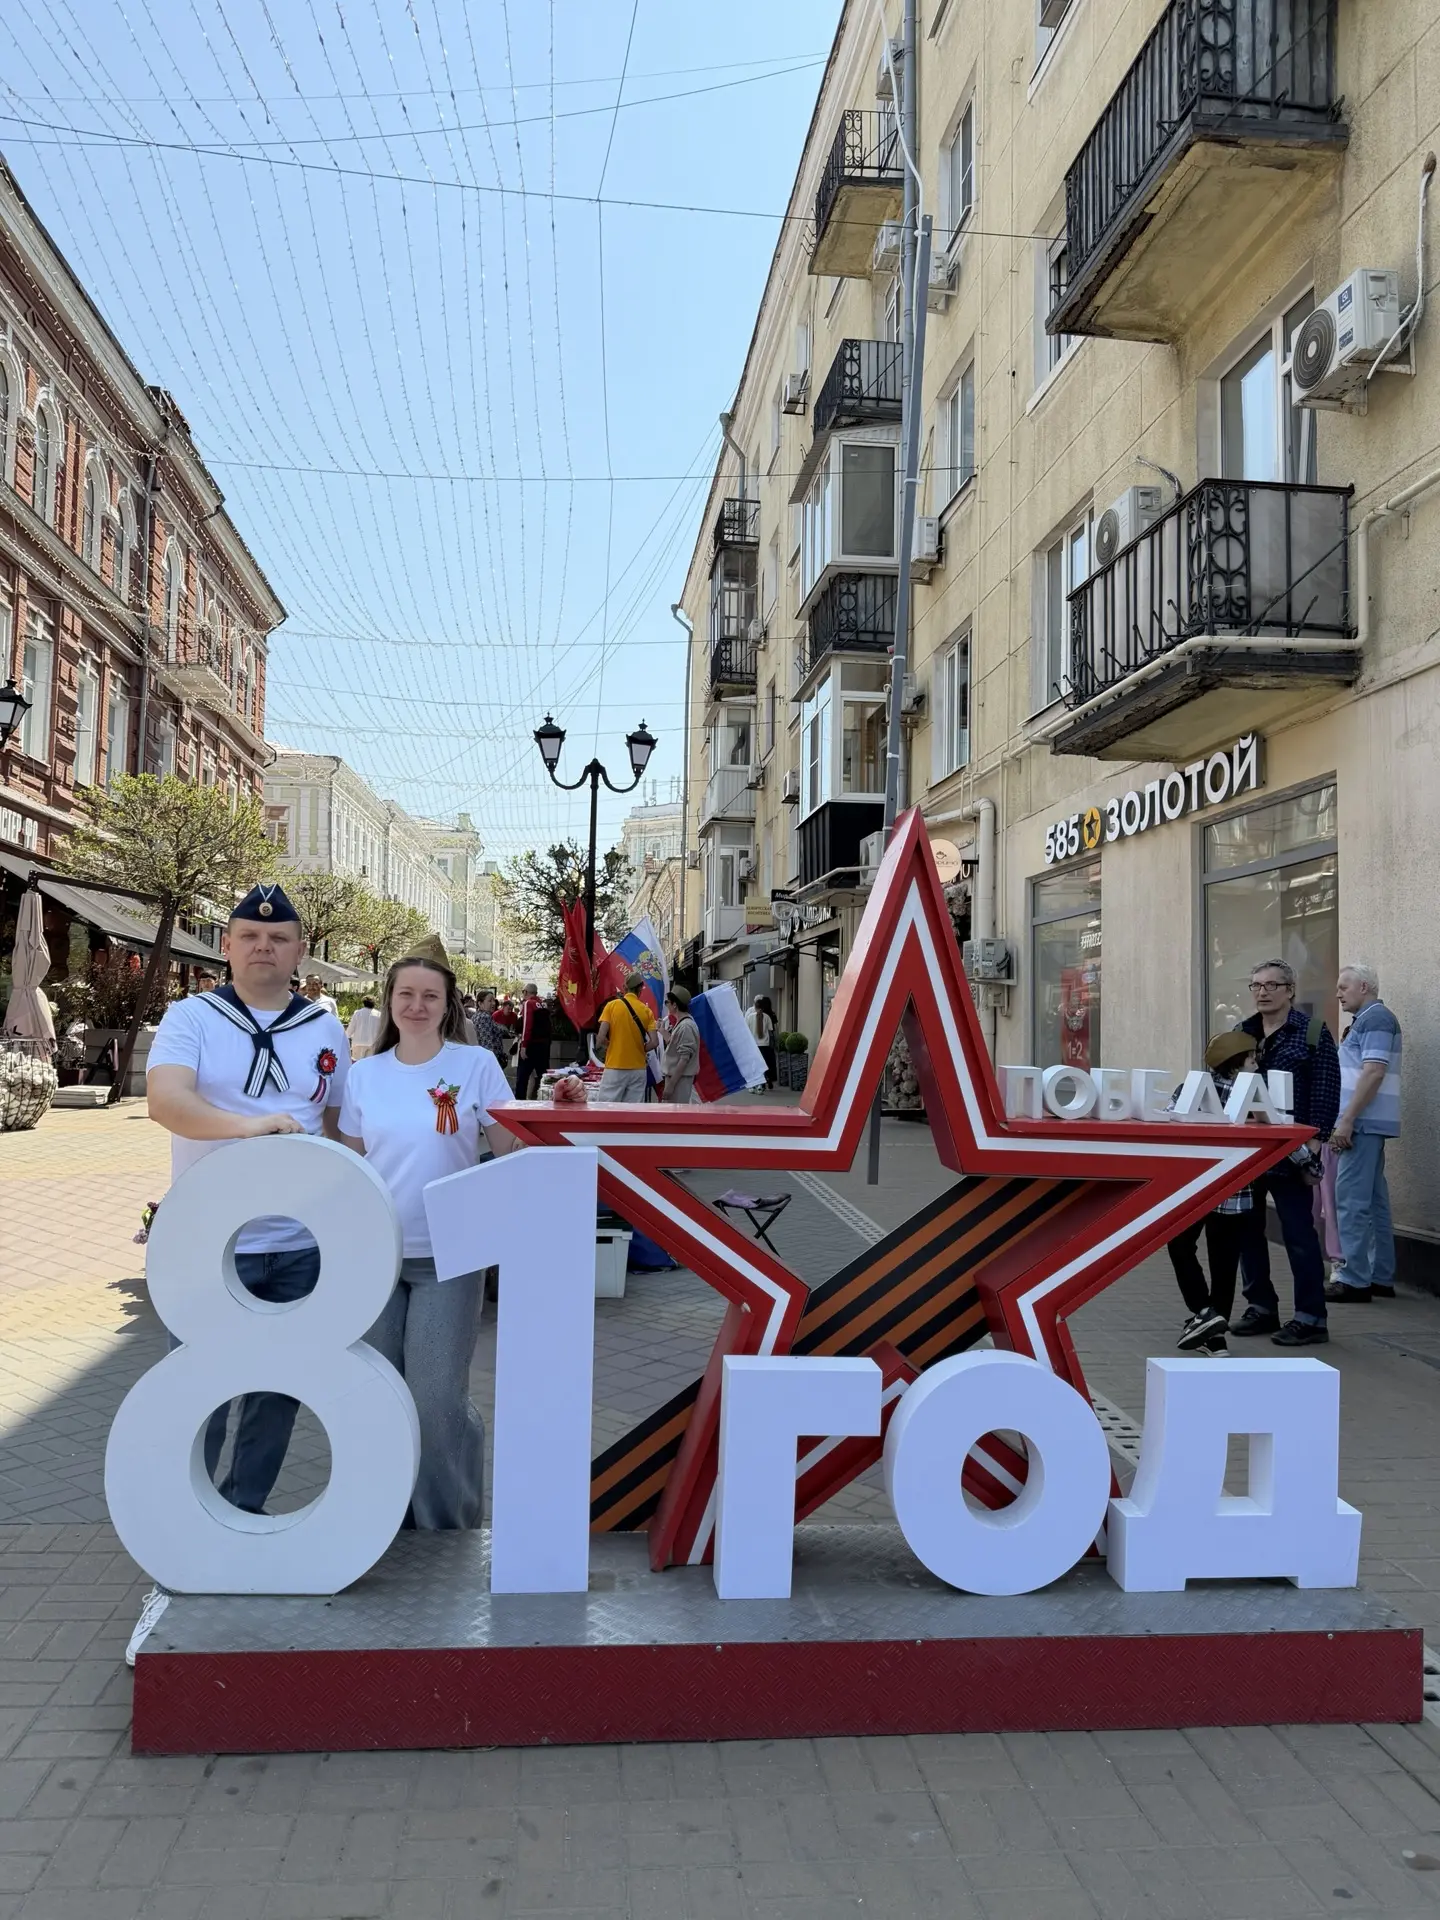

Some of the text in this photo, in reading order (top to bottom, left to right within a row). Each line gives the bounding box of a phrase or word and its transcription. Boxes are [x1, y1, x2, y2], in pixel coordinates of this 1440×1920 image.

[1045, 732, 1258, 865] 585 ЗОЛОТОЙ
[998, 1064, 1295, 1125] ПОБЕДА!
[104, 1133, 600, 1598] 81
